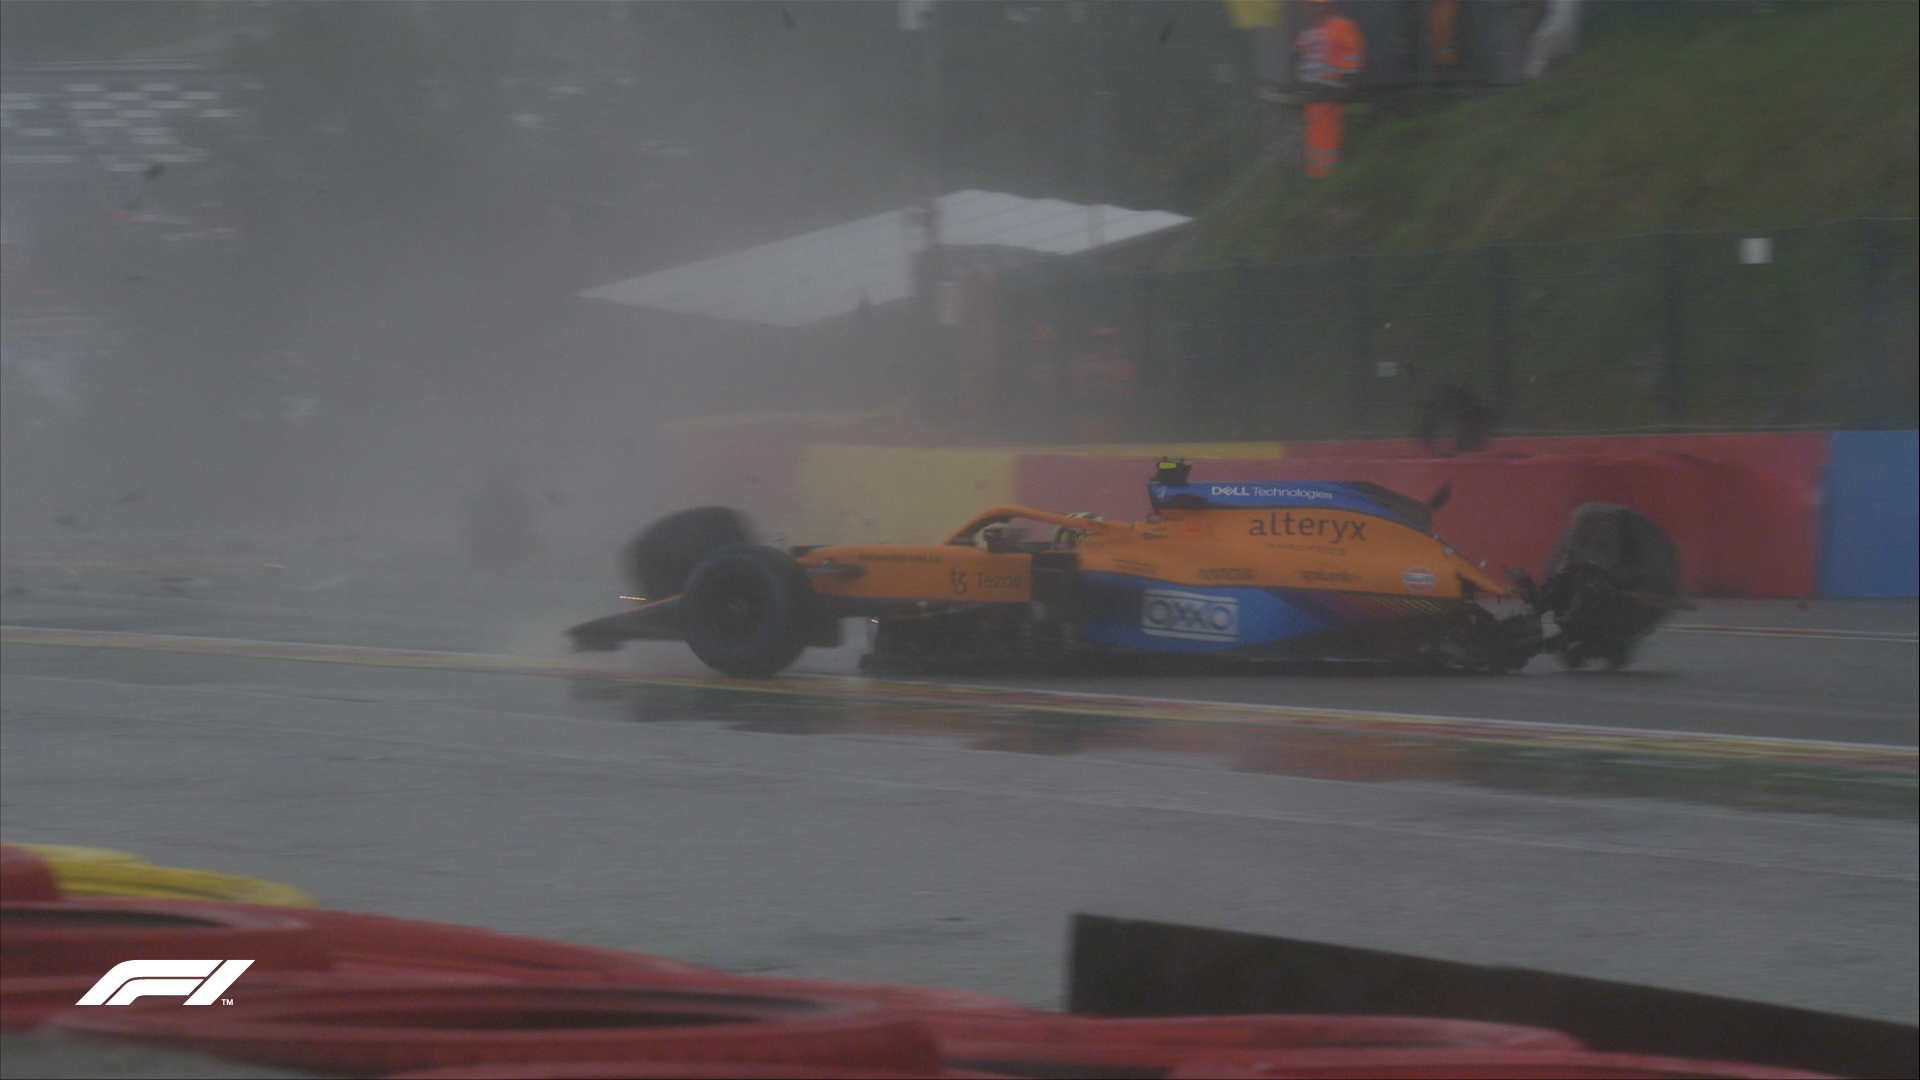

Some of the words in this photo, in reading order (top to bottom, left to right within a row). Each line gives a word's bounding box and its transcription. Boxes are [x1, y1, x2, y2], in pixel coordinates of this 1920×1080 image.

[1211, 486, 1250, 496] DELL
[1252, 487, 1333, 500] Technologies
[1248, 512, 1367, 544] alteryx
[976, 571, 1023, 590] Tezos
[1149, 600, 1234, 631] OXXO
